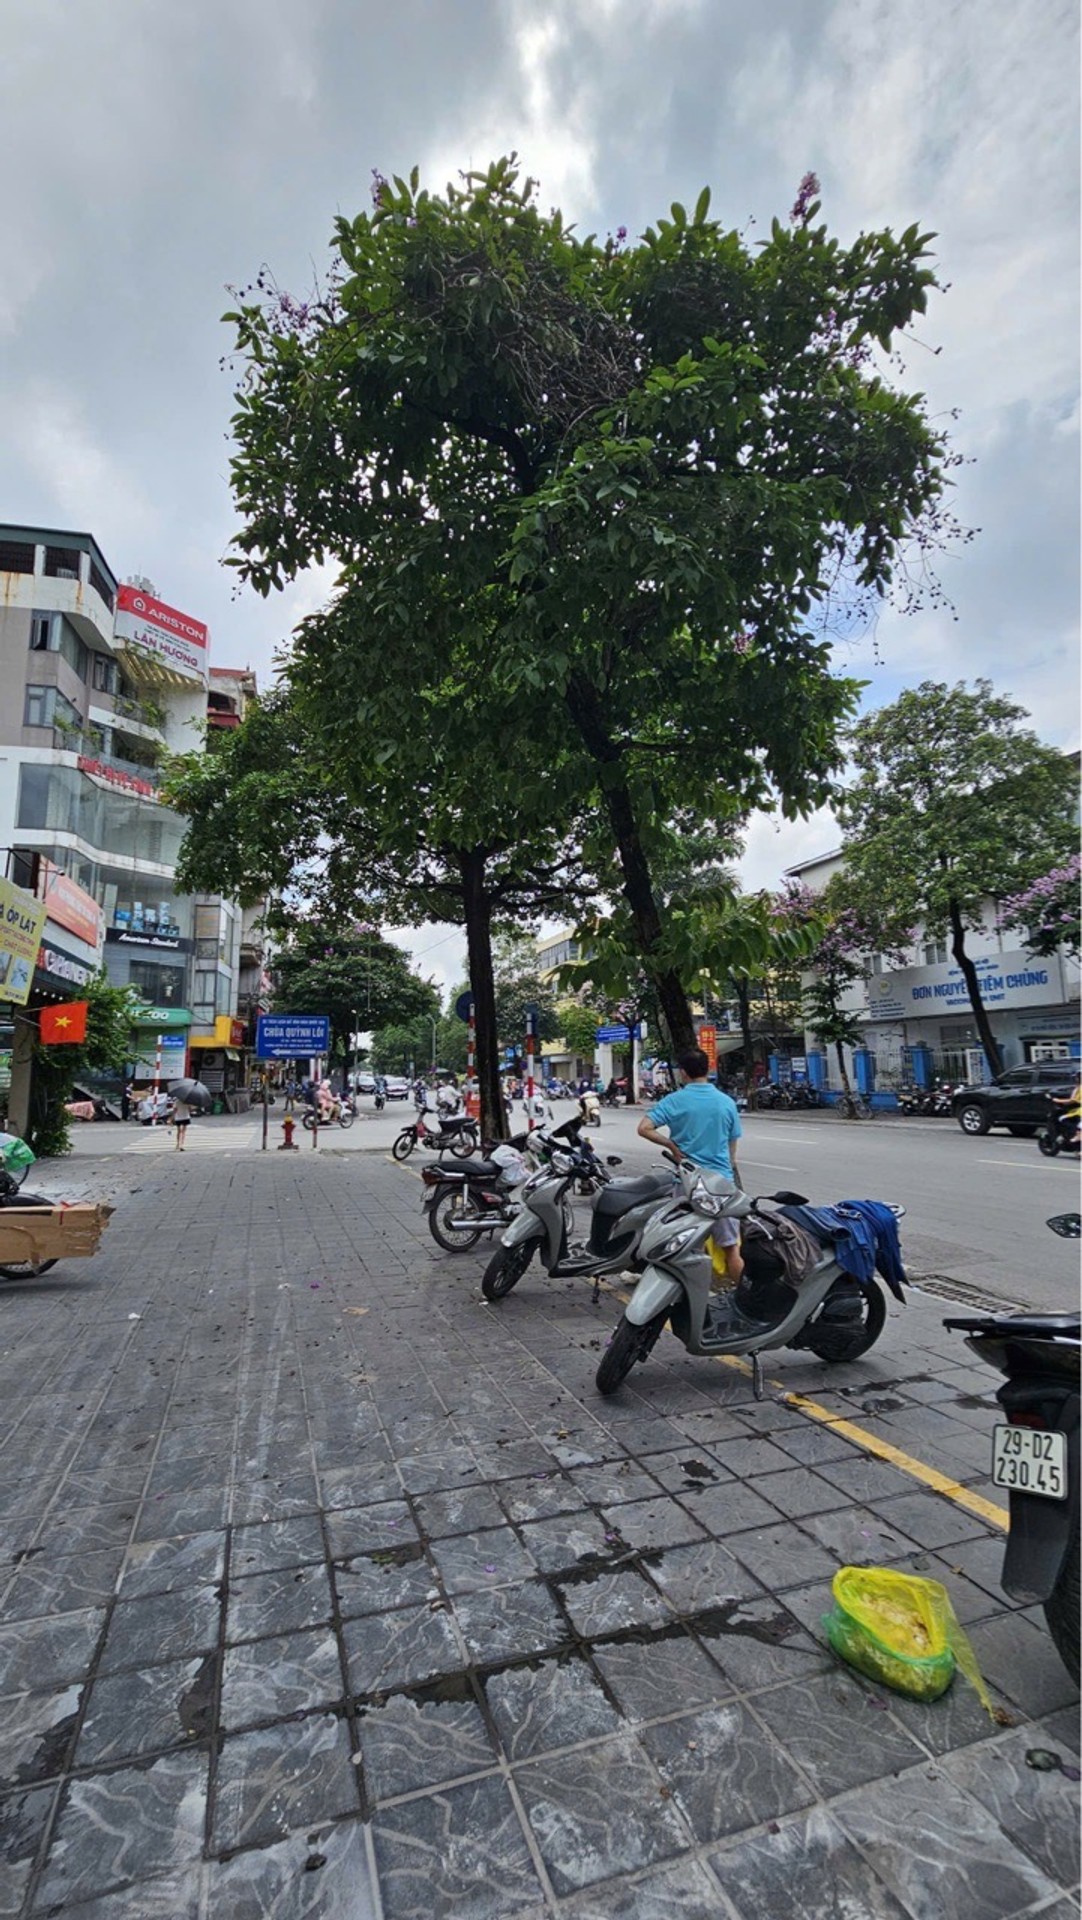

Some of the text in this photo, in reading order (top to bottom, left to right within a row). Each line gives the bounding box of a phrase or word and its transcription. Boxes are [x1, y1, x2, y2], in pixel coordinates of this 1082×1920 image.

[148, 609, 204, 640] ARISTON
[934, 979, 969, 998] NGUYÊ
[1003, 1429, 1053, 1461] 29-D2
[997, 1457, 1060, 1493] 230.45
